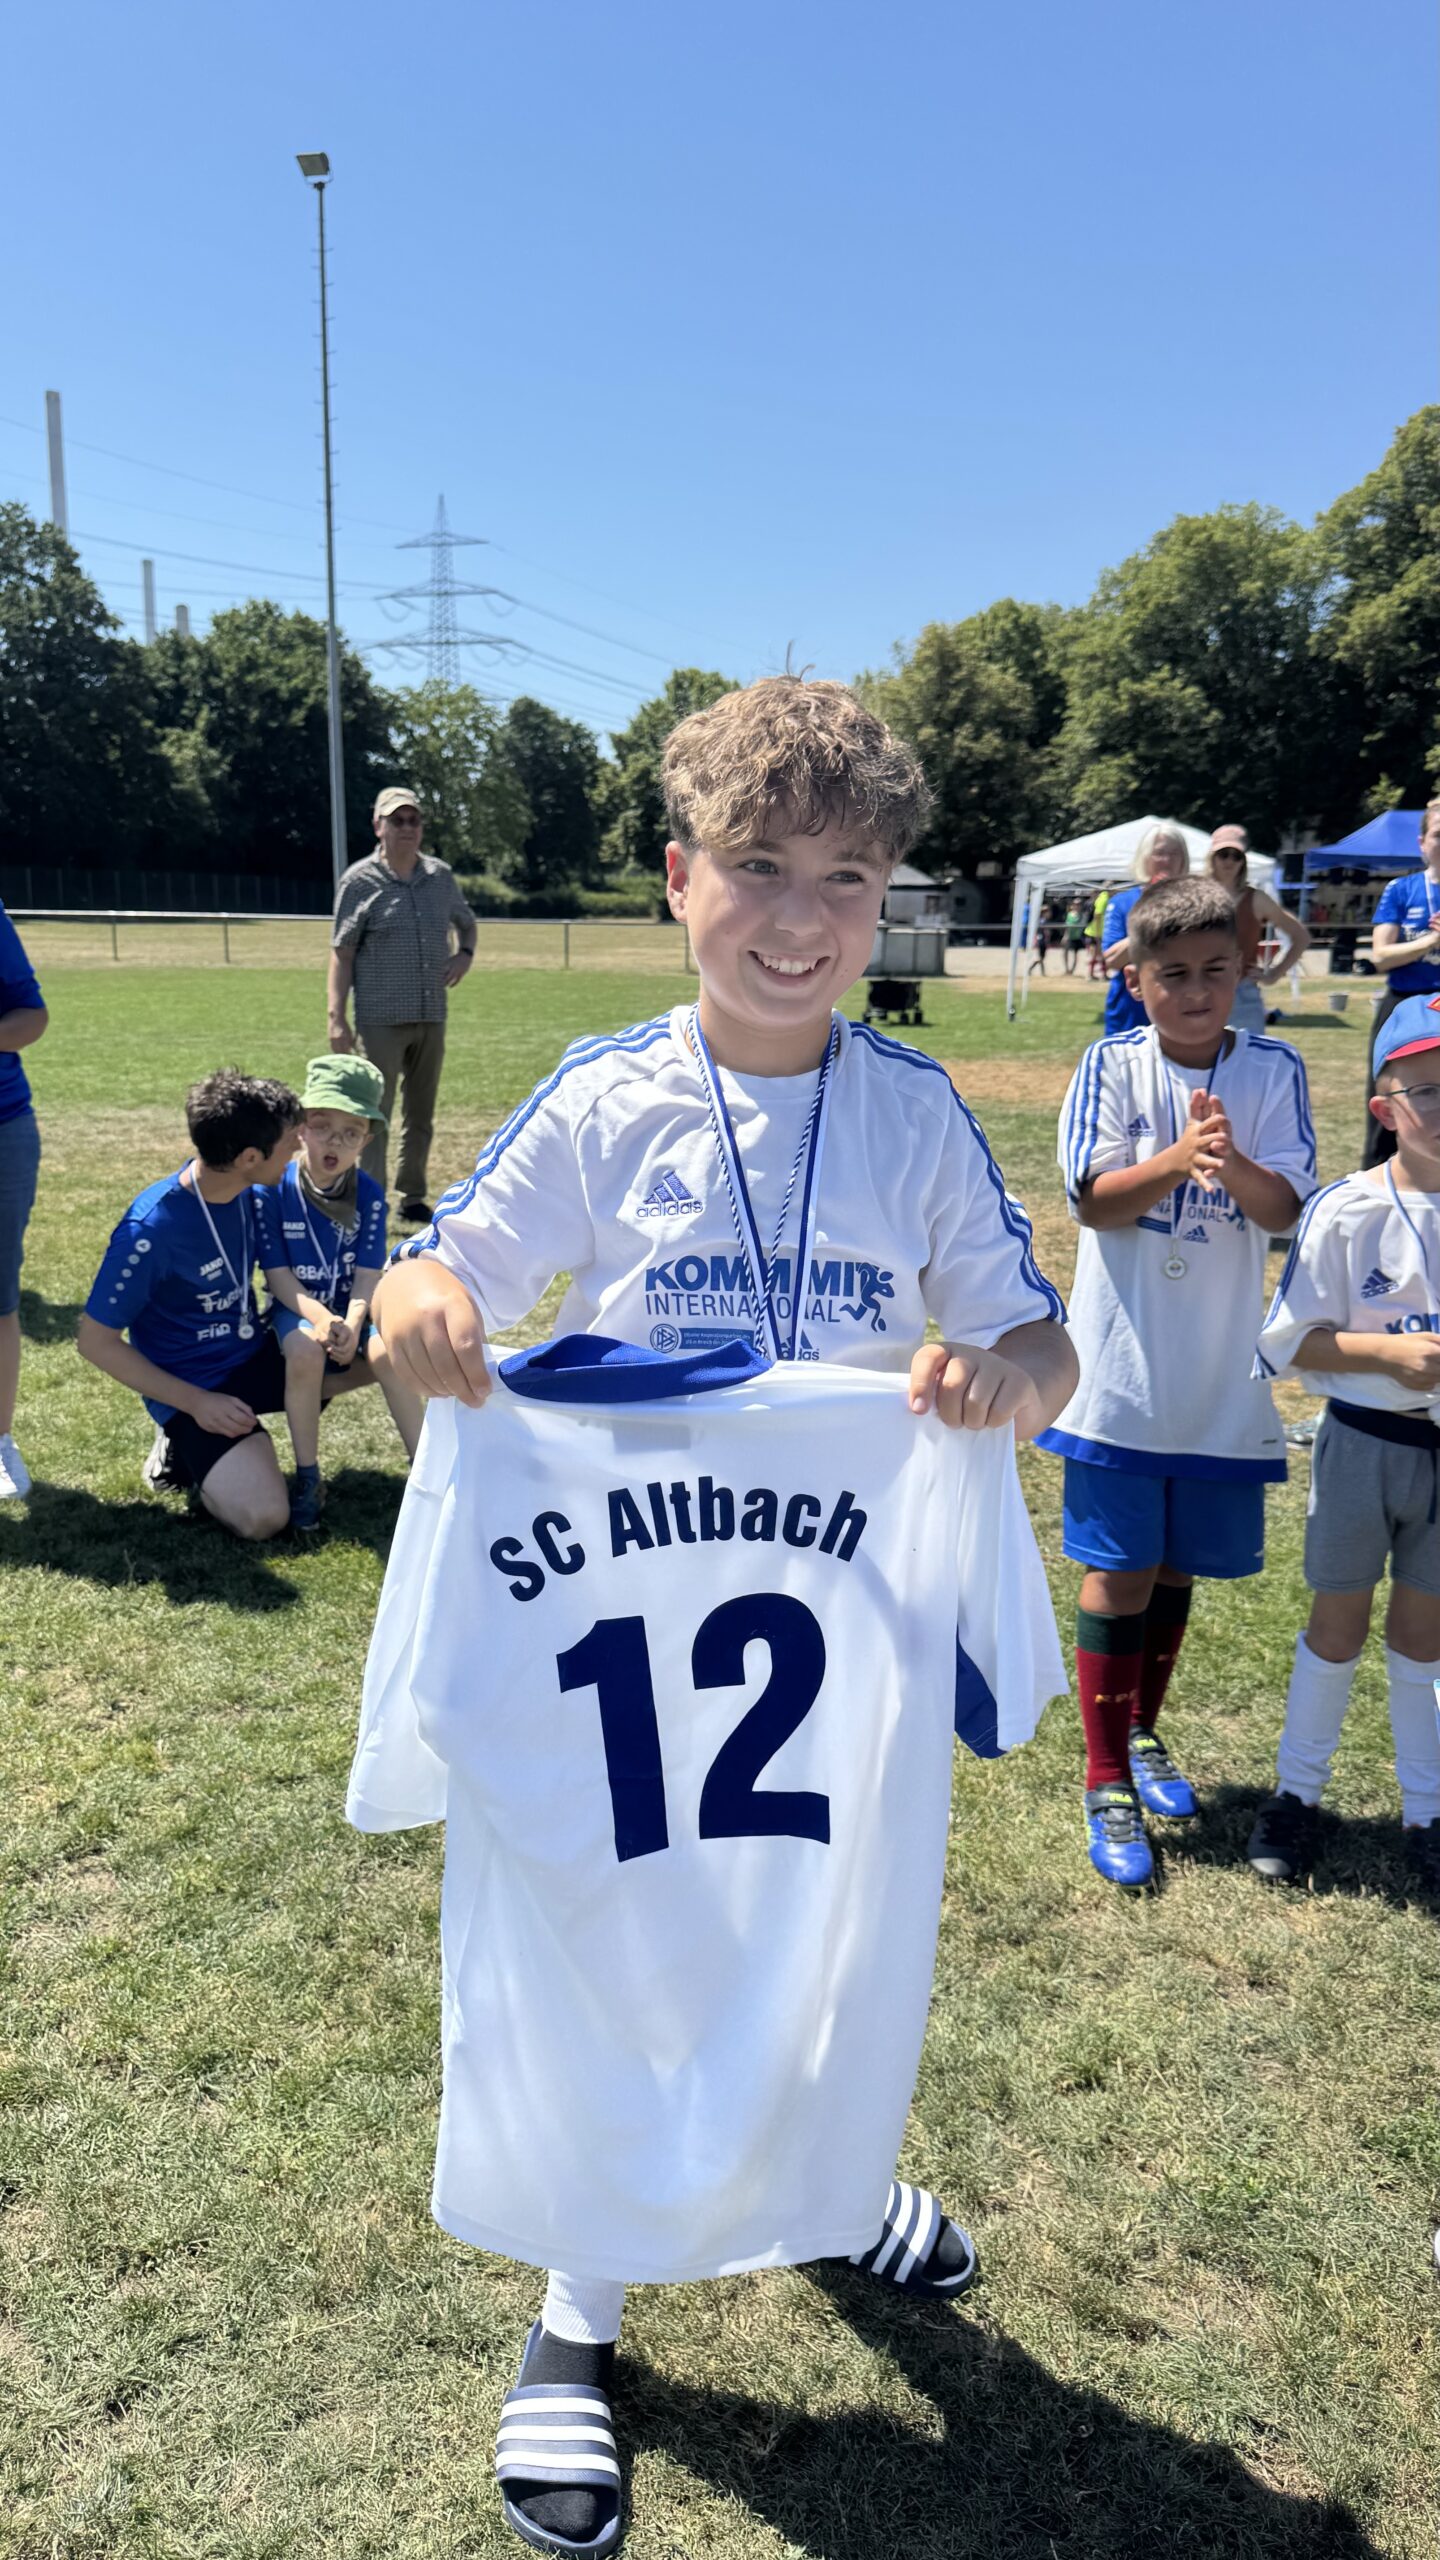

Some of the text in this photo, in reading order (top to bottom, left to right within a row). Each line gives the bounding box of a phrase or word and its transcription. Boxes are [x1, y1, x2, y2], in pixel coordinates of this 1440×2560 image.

[637, 1200, 704, 1218] adidas
[645, 1292, 841, 1323] INTERNAOAL
[489, 1476, 868, 1602] SC Altbach
[556, 1592, 830, 1863] 12
